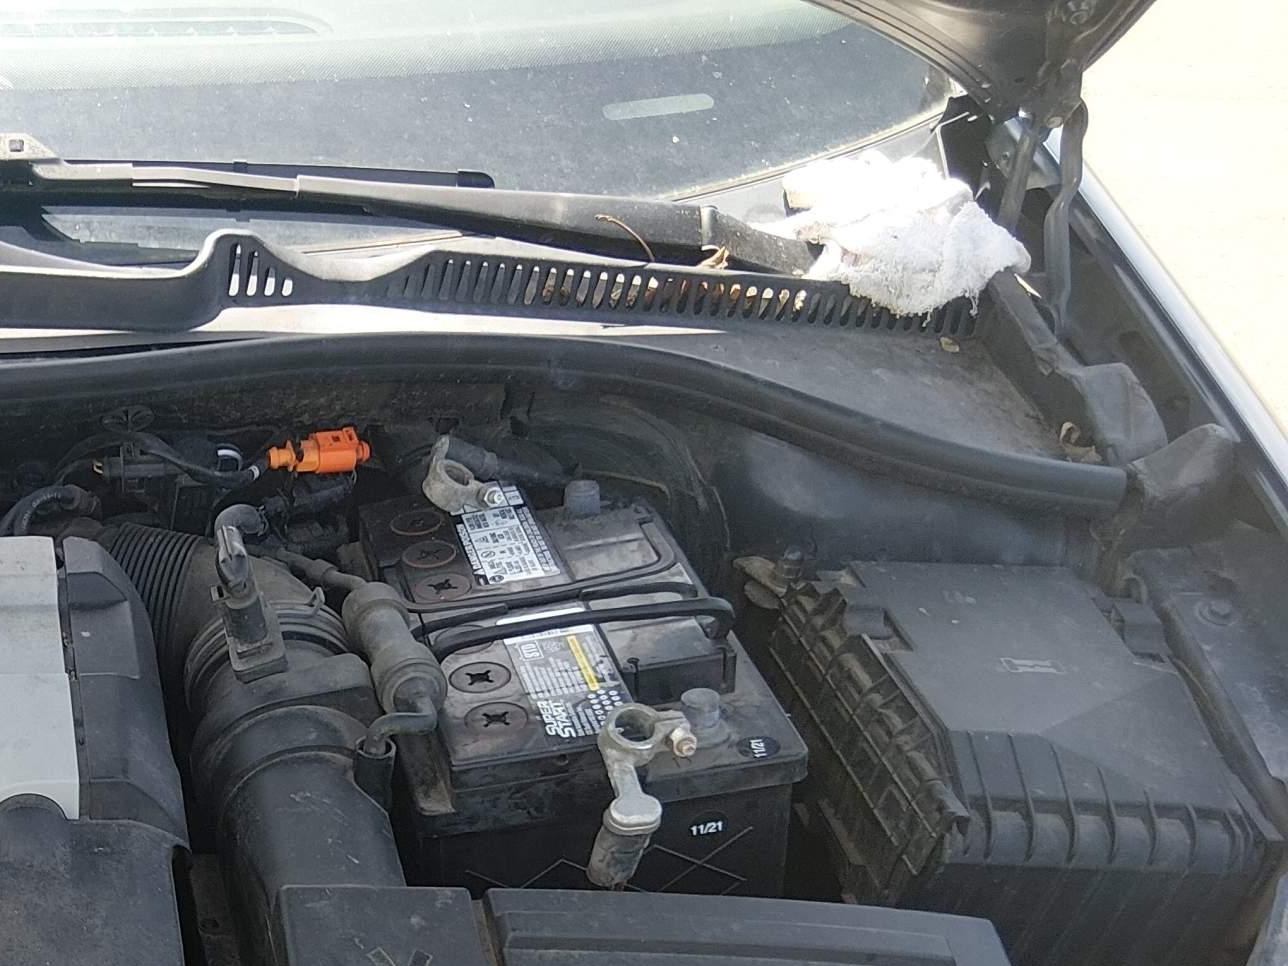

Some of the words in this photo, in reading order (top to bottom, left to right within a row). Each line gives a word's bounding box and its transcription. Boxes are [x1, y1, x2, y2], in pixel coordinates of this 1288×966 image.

[537, 700, 556, 736] SUPER
[549, 699, 577, 738] START
[750, 739, 767, 758] 11/21
[691, 821, 723, 836] 11/21
